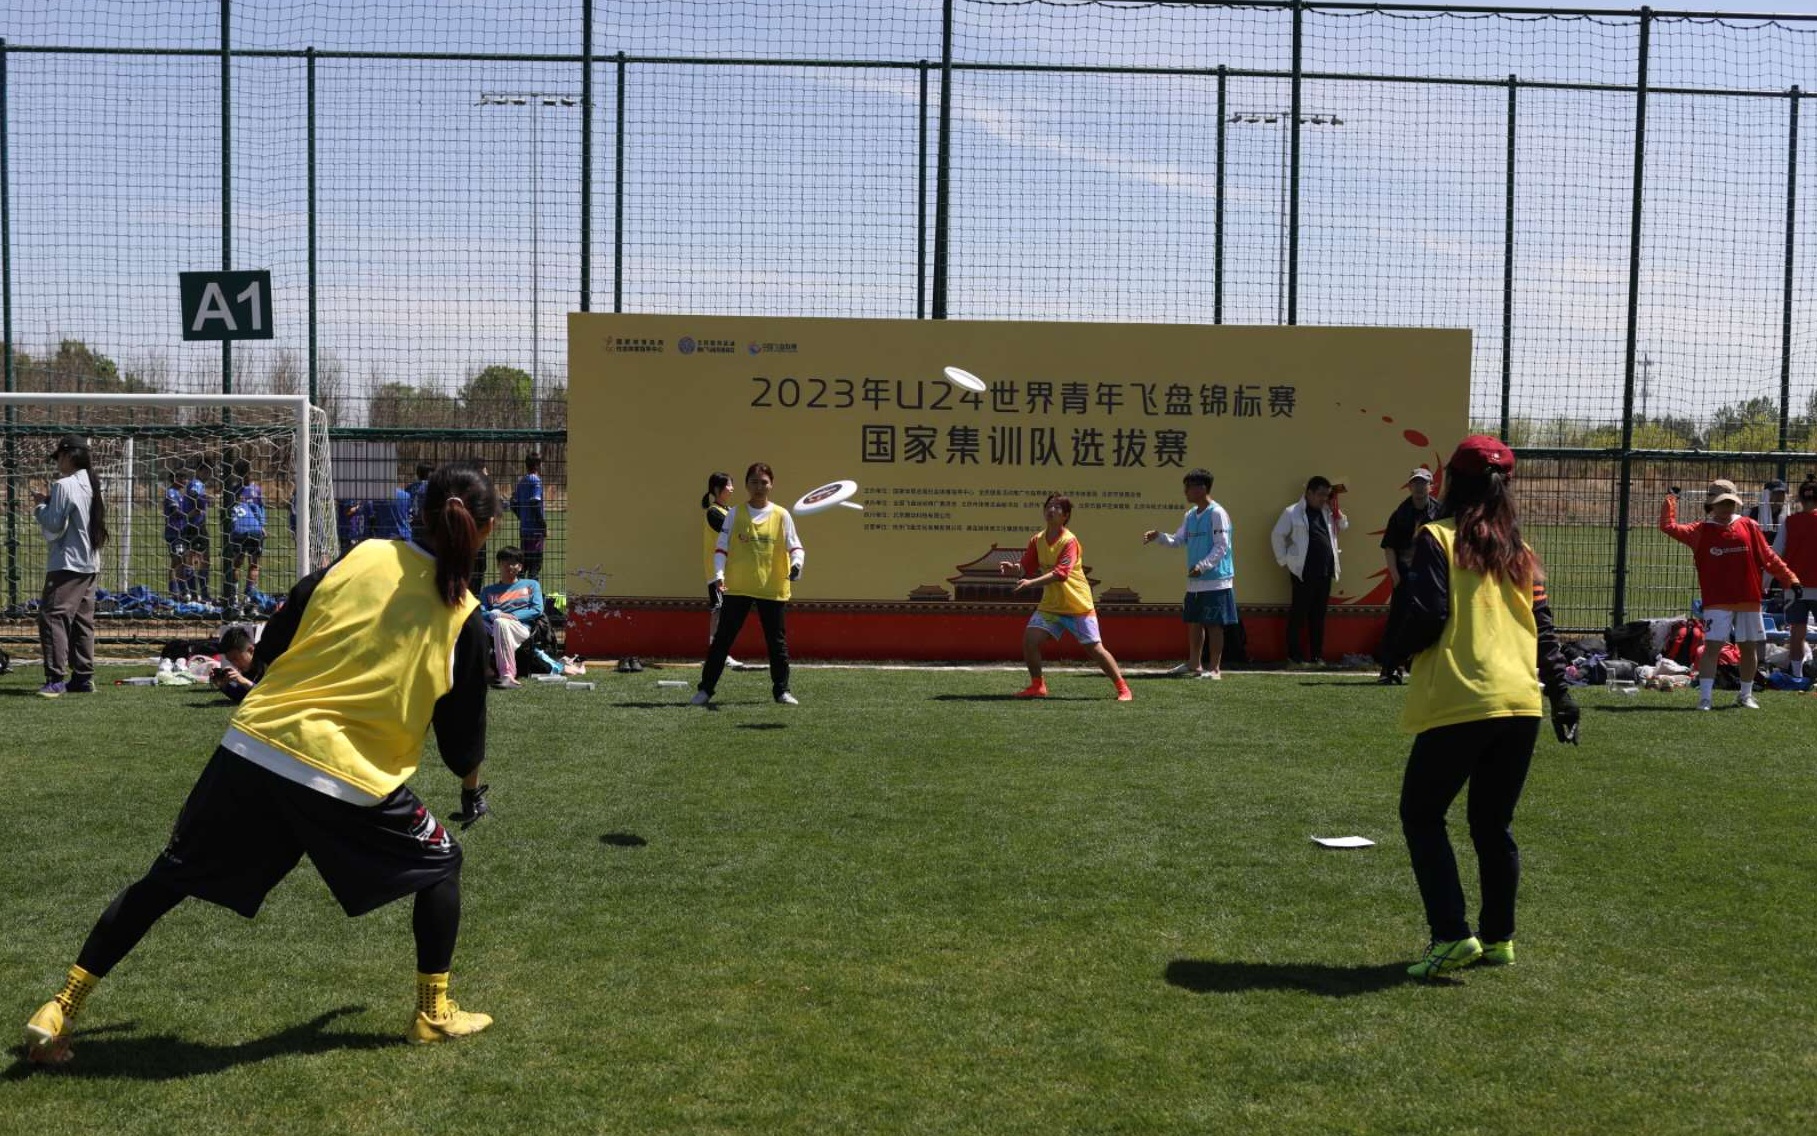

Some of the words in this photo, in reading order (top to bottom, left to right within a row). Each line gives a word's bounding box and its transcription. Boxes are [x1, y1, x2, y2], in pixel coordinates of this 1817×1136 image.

[191, 280, 262, 331] A1
[860, 424, 1189, 468] 国家集训队选拔赛
